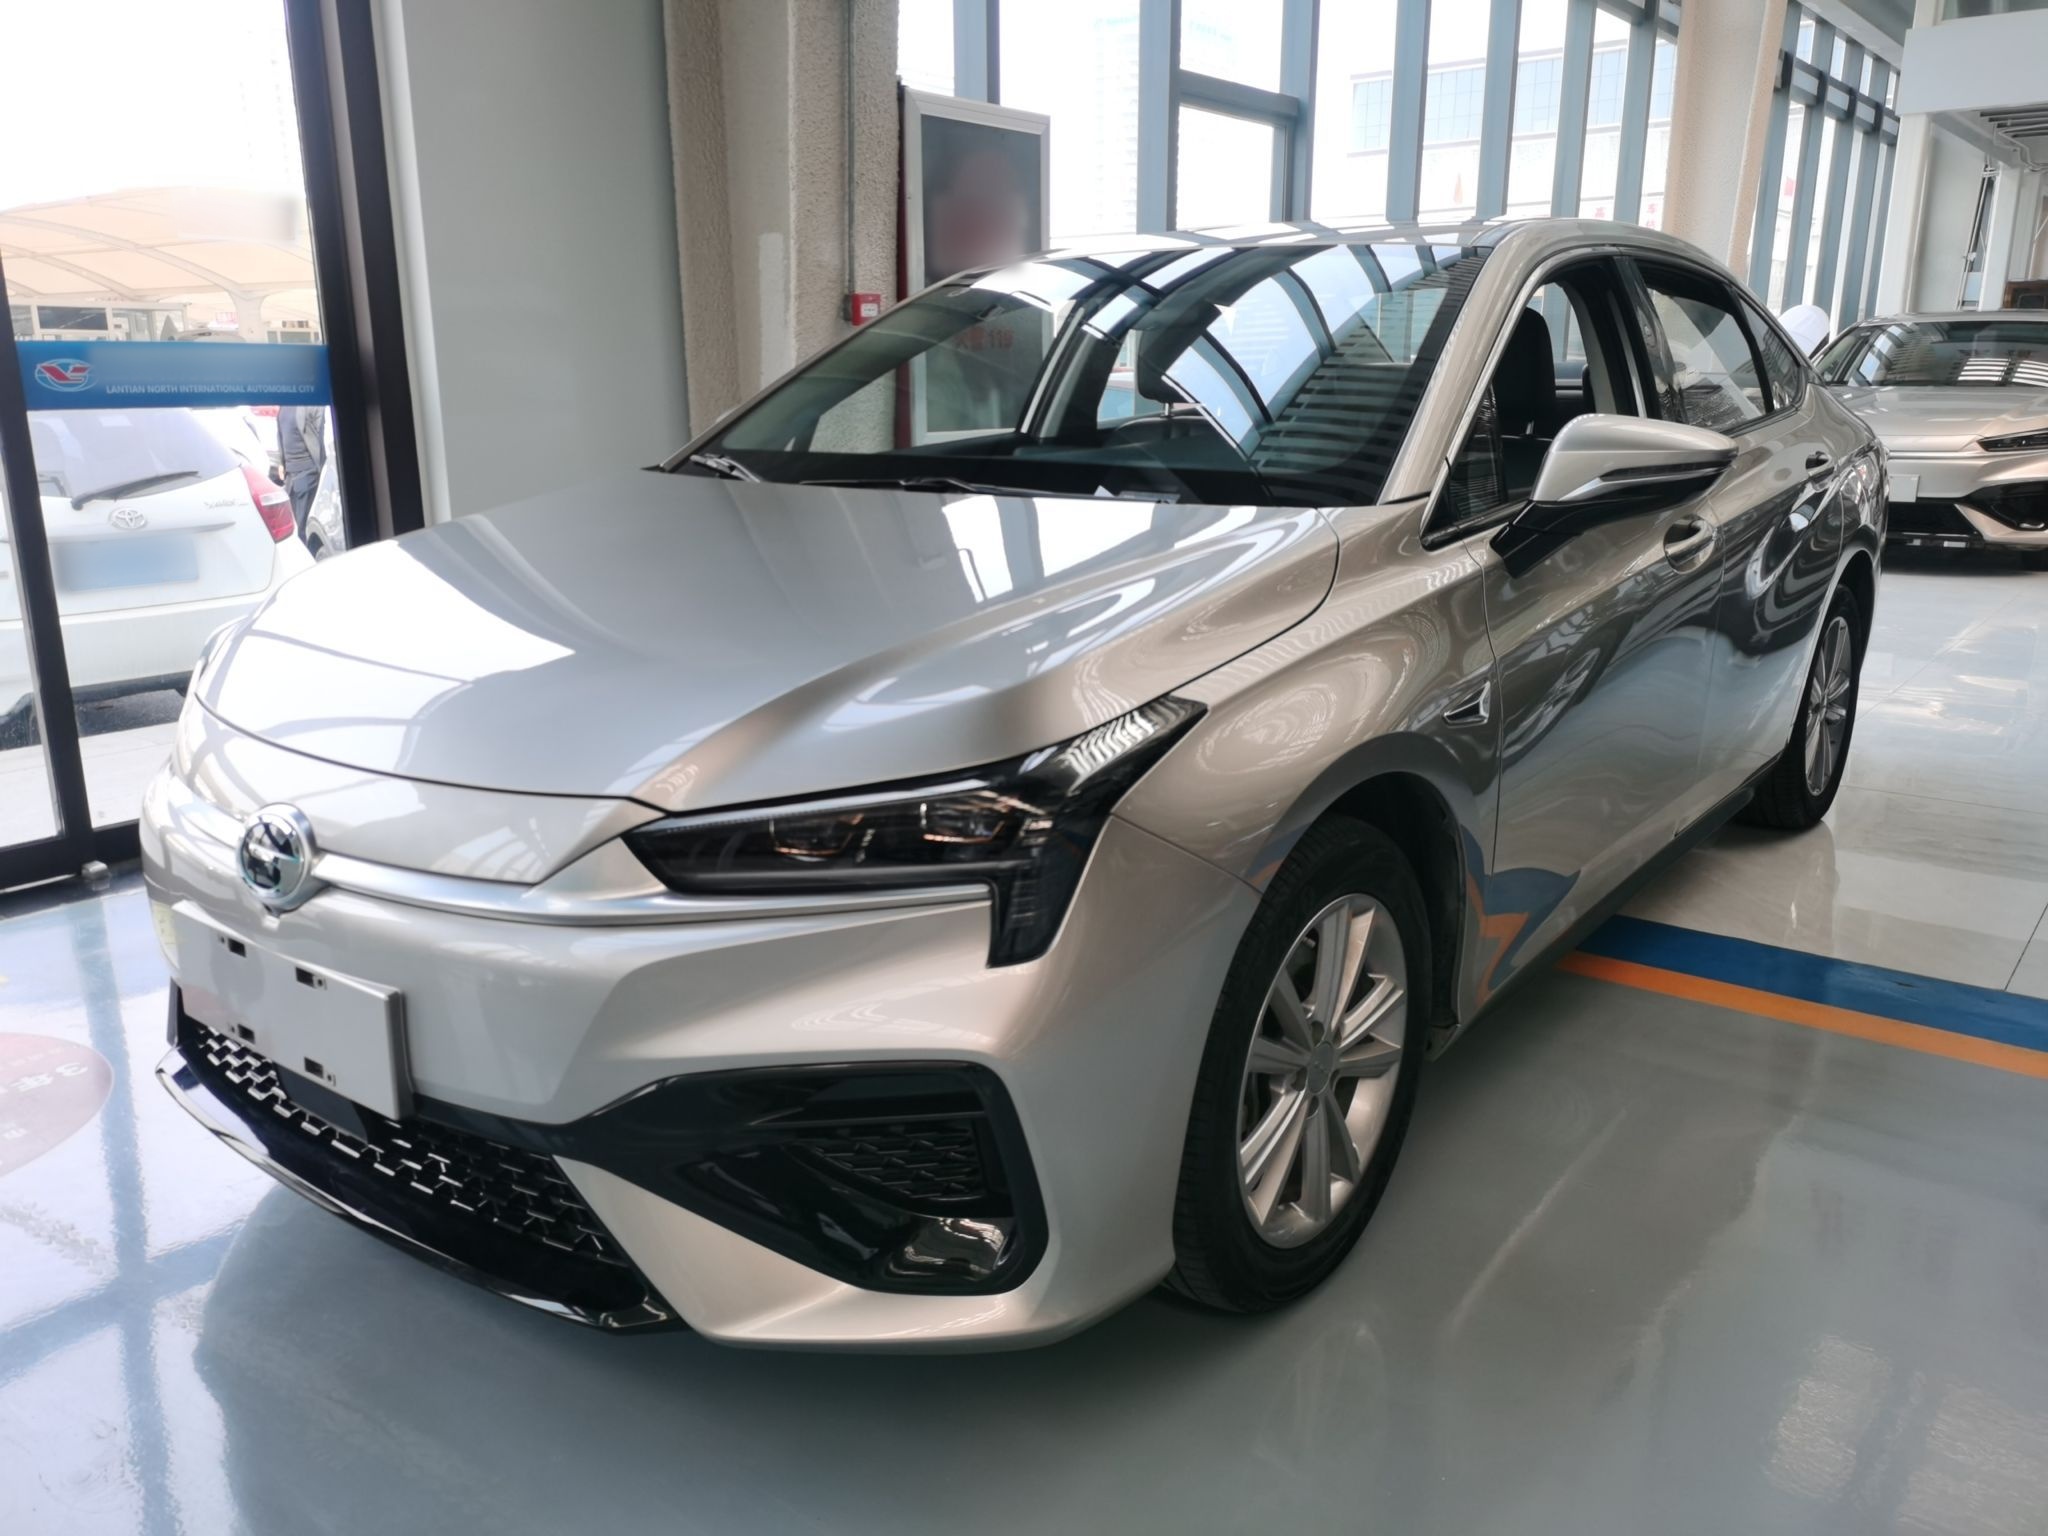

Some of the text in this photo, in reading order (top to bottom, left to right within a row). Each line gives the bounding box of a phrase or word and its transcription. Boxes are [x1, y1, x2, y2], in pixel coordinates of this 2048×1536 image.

[106, 383, 315, 394] LANTIAN NORTH INTERNATIONAL AUTOMOBILE CITY
